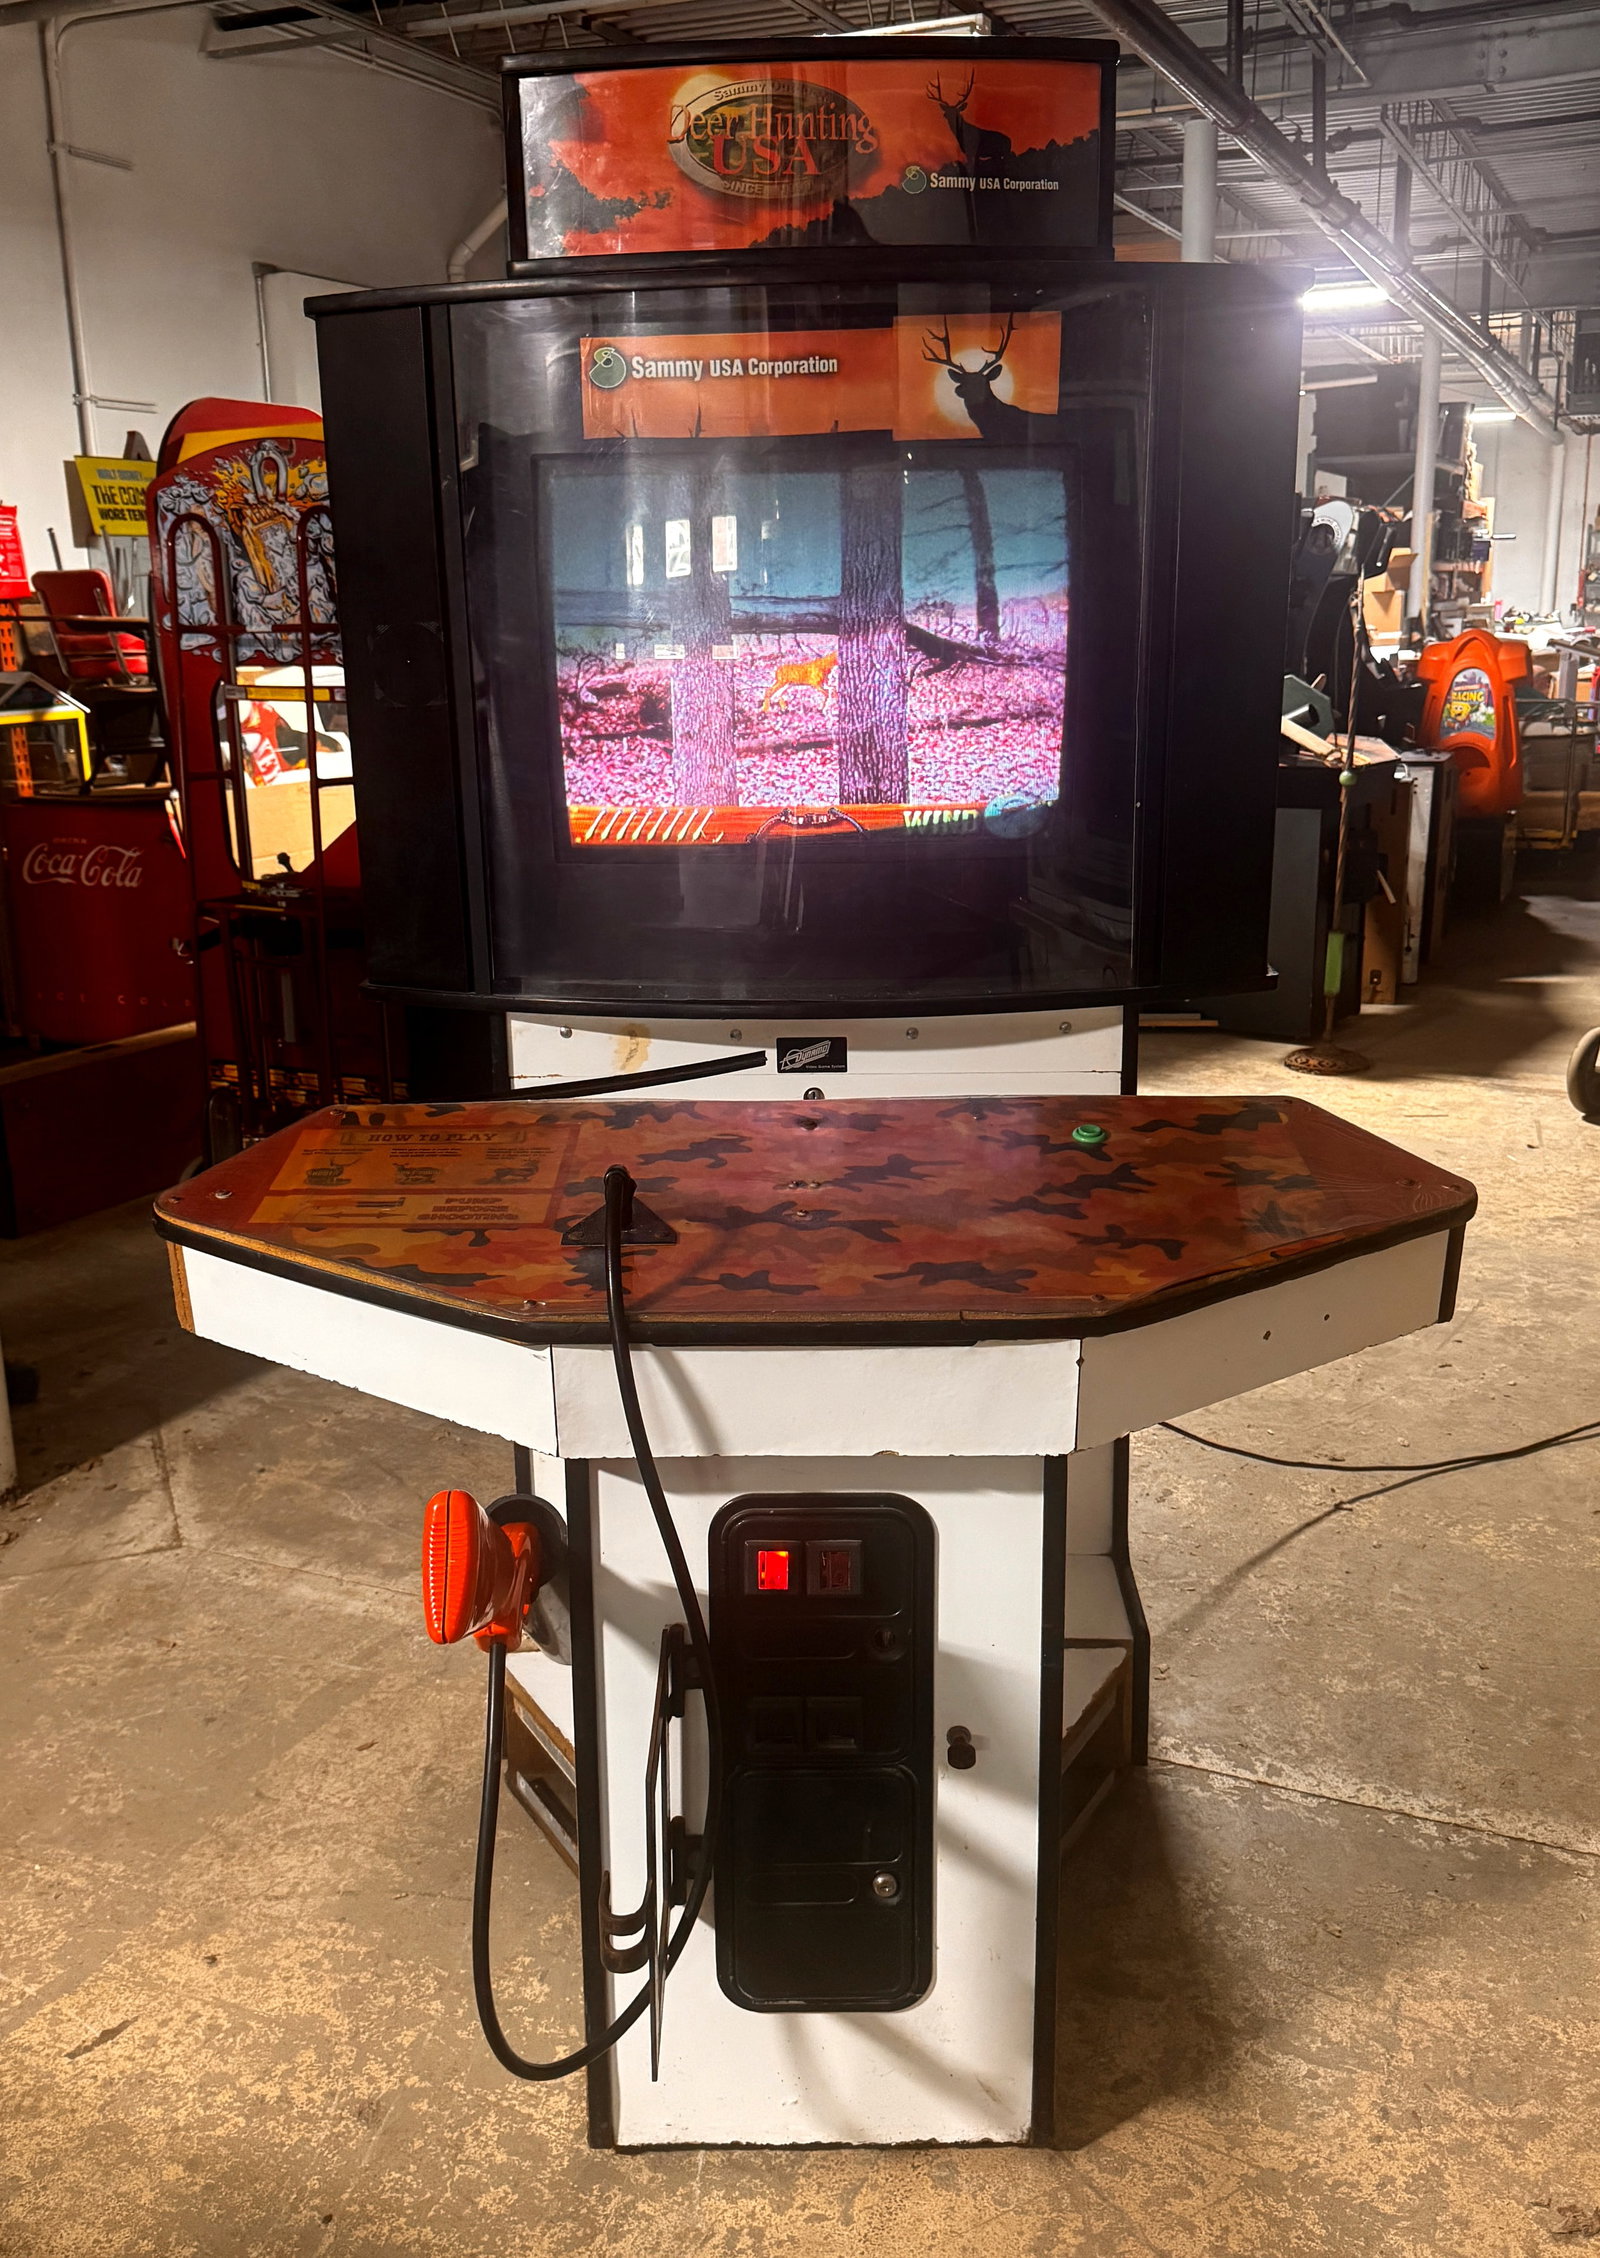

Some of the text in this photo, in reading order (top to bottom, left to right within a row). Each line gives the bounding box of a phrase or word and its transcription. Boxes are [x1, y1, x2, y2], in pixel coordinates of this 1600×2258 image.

[714, 82, 767, 101] Sammy
[668, 103, 878, 154] Deer Hunting
[711, 134, 820, 175] USA
[930, 172, 1059, 192] Sammy USA Corporation
[631, 356, 838, 382] Sammy USA Corporation
[91, 485, 119, 505] THE
[367, 1133, 499, 1142] HOW TO PLAY
